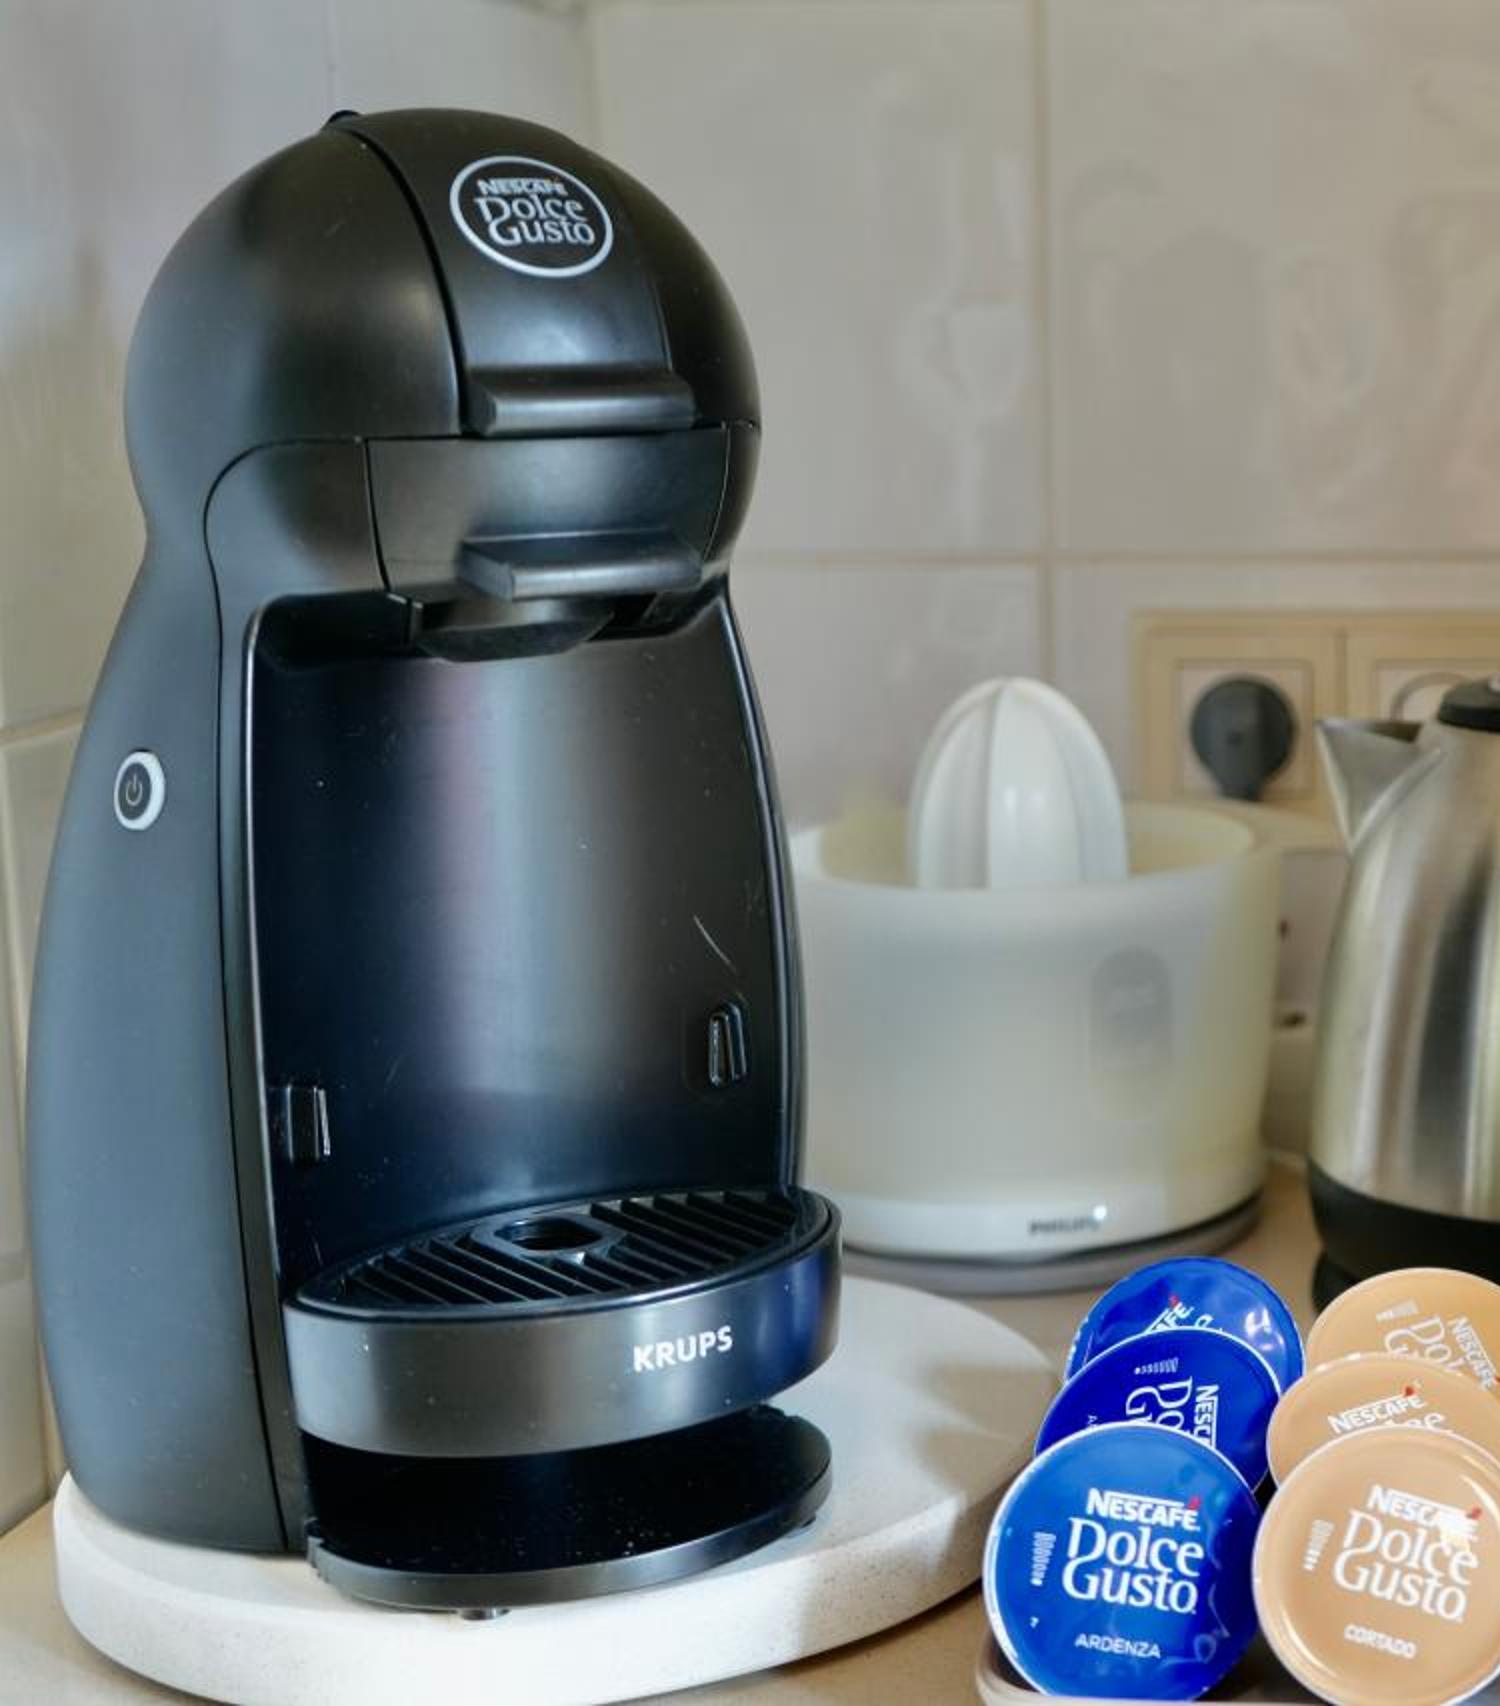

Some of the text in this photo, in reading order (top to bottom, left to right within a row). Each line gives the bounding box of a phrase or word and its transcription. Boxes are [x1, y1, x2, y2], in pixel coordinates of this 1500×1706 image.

[473, 194, 589, 222] Dolce
[488, 219, 596, 247] Gusto
[632, 1325, 734, 1373] KRUPS
[1194, 1385, 1219, 1446] NESC
[1066, 1516, 1205, 1577] Dolce
[1343, 1508, 1479, 1586] Dolce
[1061, 1556, 1198, 1614] Gusto
[1333, 1549, 1465, 1623] Gusto
[1075, 1633, 1161, 1659] ARDENZA
[1344, 1623, 1417, 1659] CORTADO
